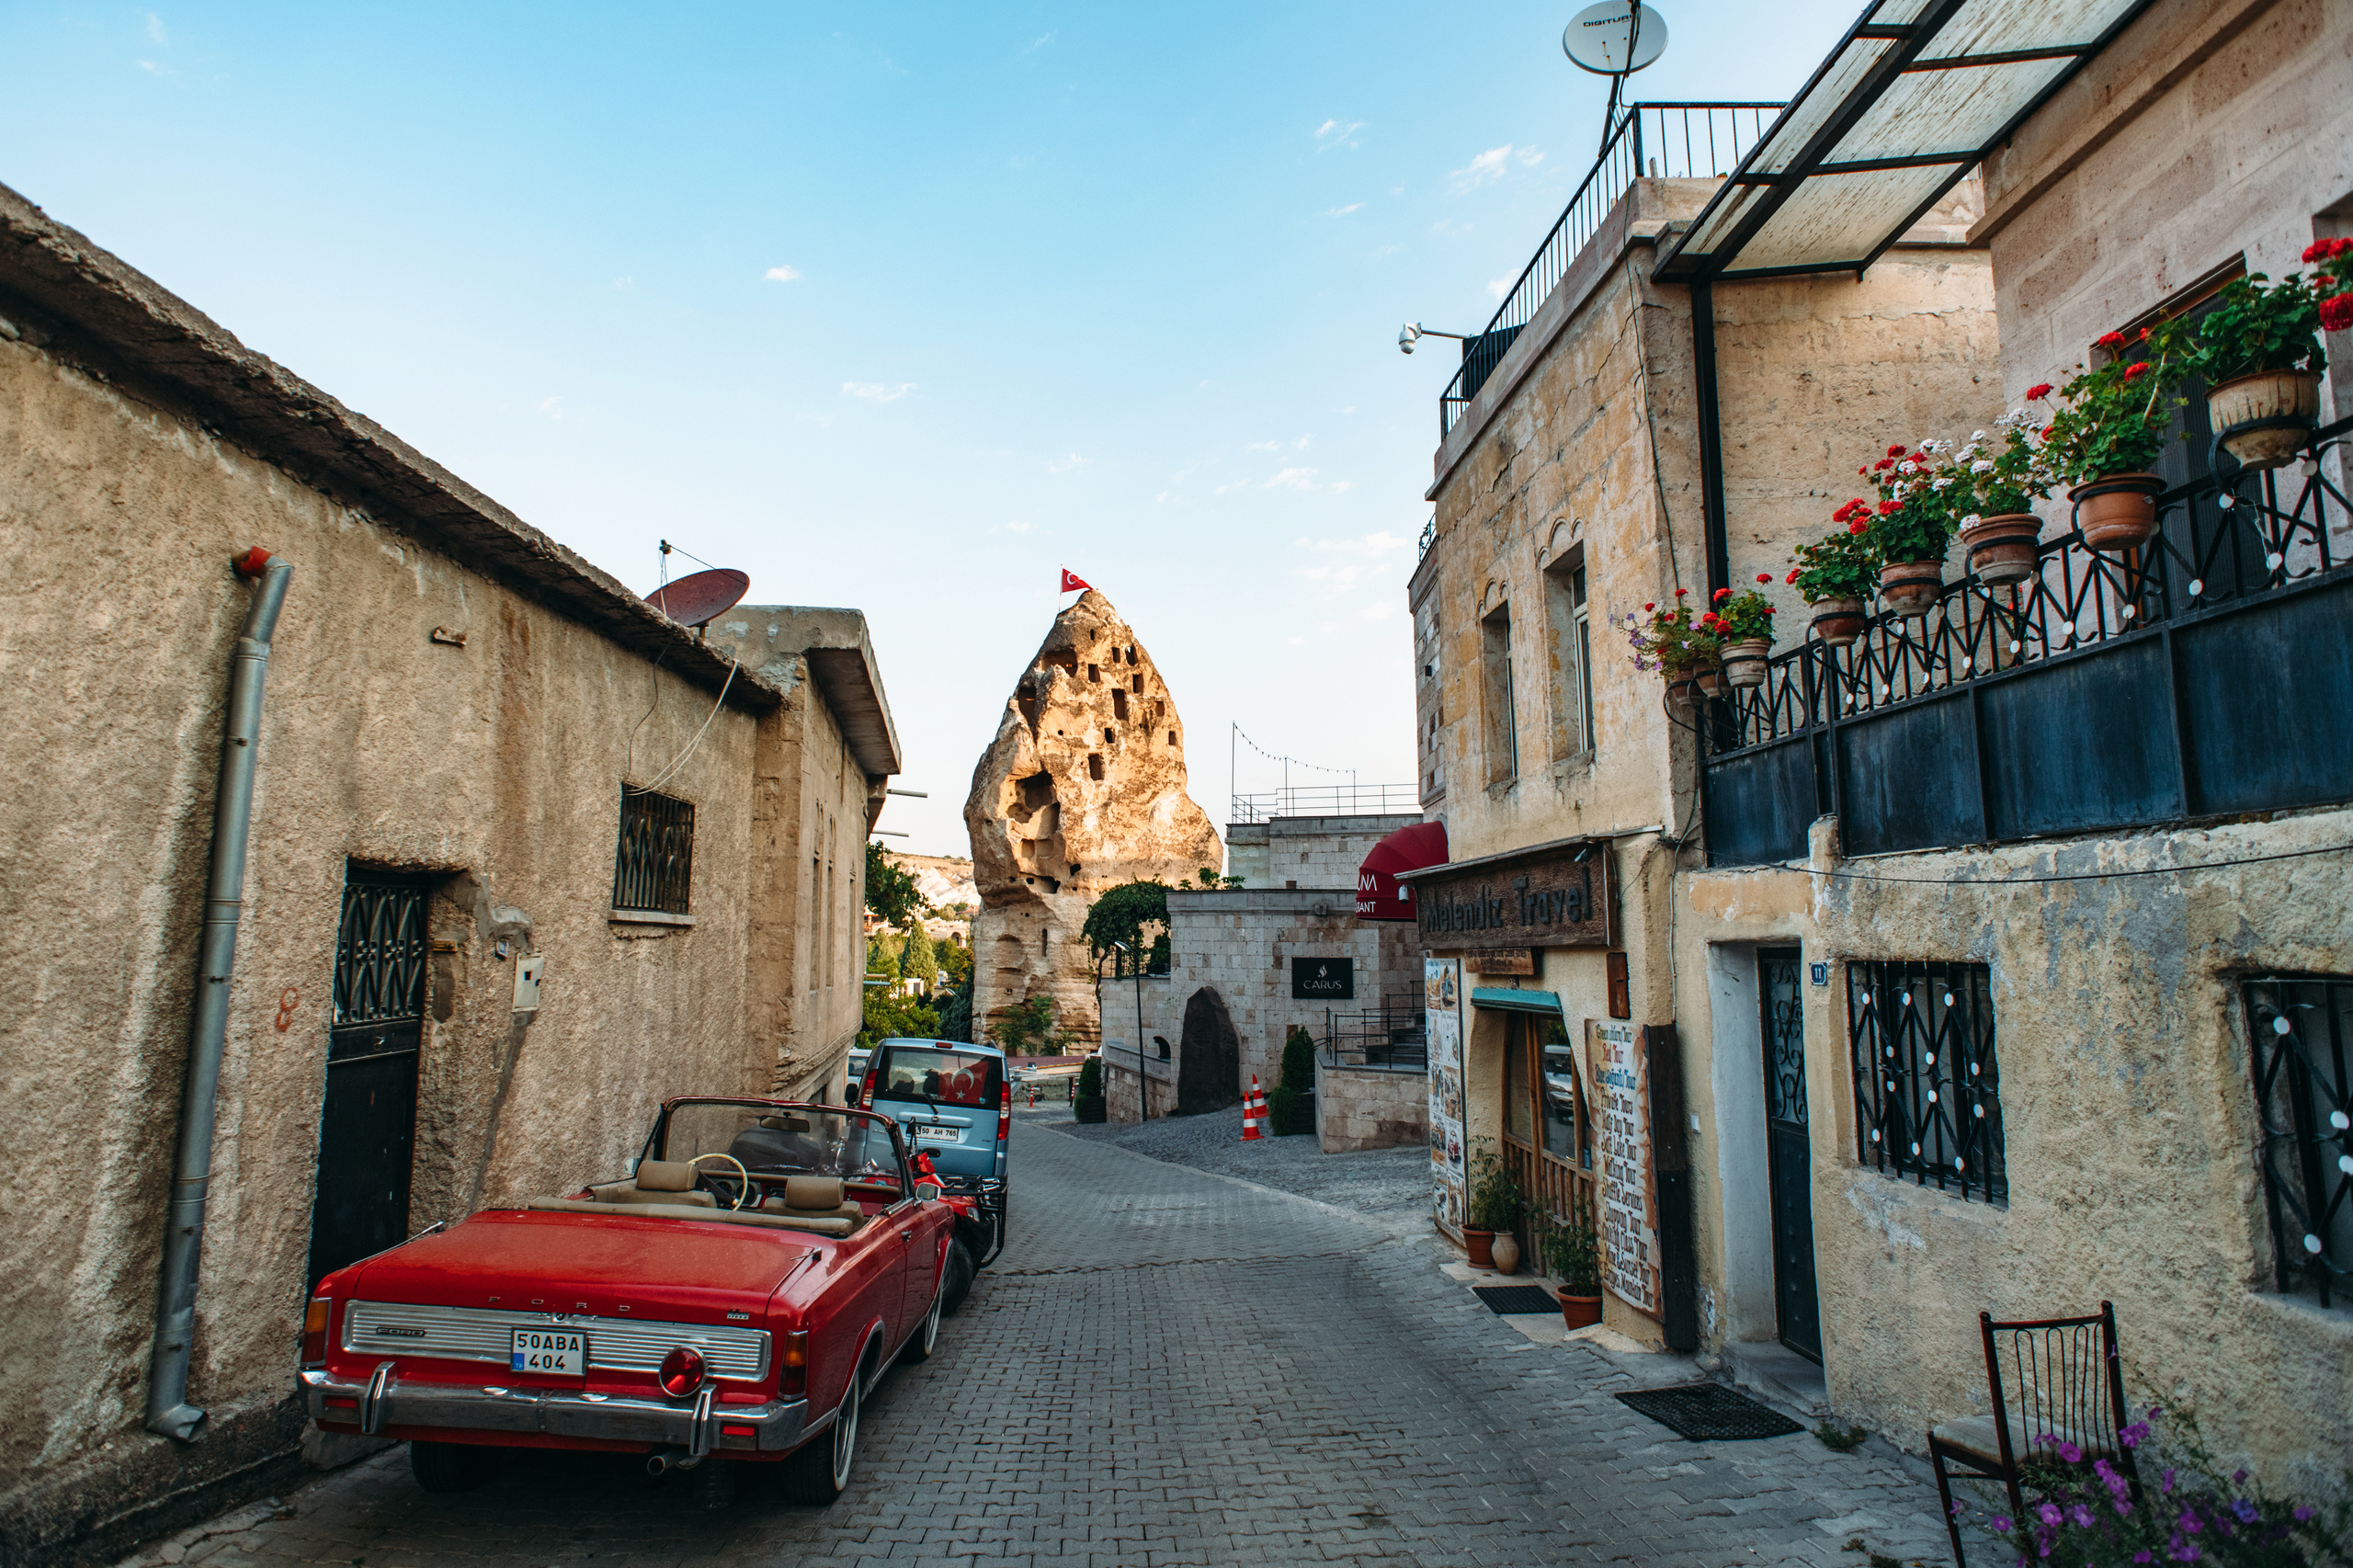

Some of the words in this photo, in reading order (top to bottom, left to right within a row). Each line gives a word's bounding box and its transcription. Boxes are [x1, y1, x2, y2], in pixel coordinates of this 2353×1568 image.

[1427, 885, 1503, 932] Melendiz
[1512, 867, 1593, 927] Travel
[1303, 980, 1342, 990] CARUS
[1814, 968, 1822, 979] 11
[1602, 1042, 1611, 1062] Red
[1612, 1043, 1623, 1064] Tour
[1600, 1086, 1619, 1110] Private
[1619, 1093, 1633, 1115] Tours
[934, 1128, 943, 1136] AH
[946, 1129, 957, 1137] 765
[1623, 1117, 1634, 1137] Tour
[1613, 1134, 1625, 1158] Lake
[1625, 1138, 1637, 1161] Tour
[1623, 1161, 1636, 1186] Tour
[1620, 1184, 1643, 1212] Services
[1604, 1200, 1627, 1233] Shopping
[1627, 1210, 1641, 1235] Tour
[1633, 1235, 1647, 1262] Tour
[1638, 1261, 1651, 1286] Tour
[488, 1296, 631, 1312] FORD
[1642, 1283, 1654, 1309] Tour
[377, 1328, 424, 1336] FORD
[517, 1333, 579, 1351] 50ABA
[529, 1353, 566, 1369] 404
